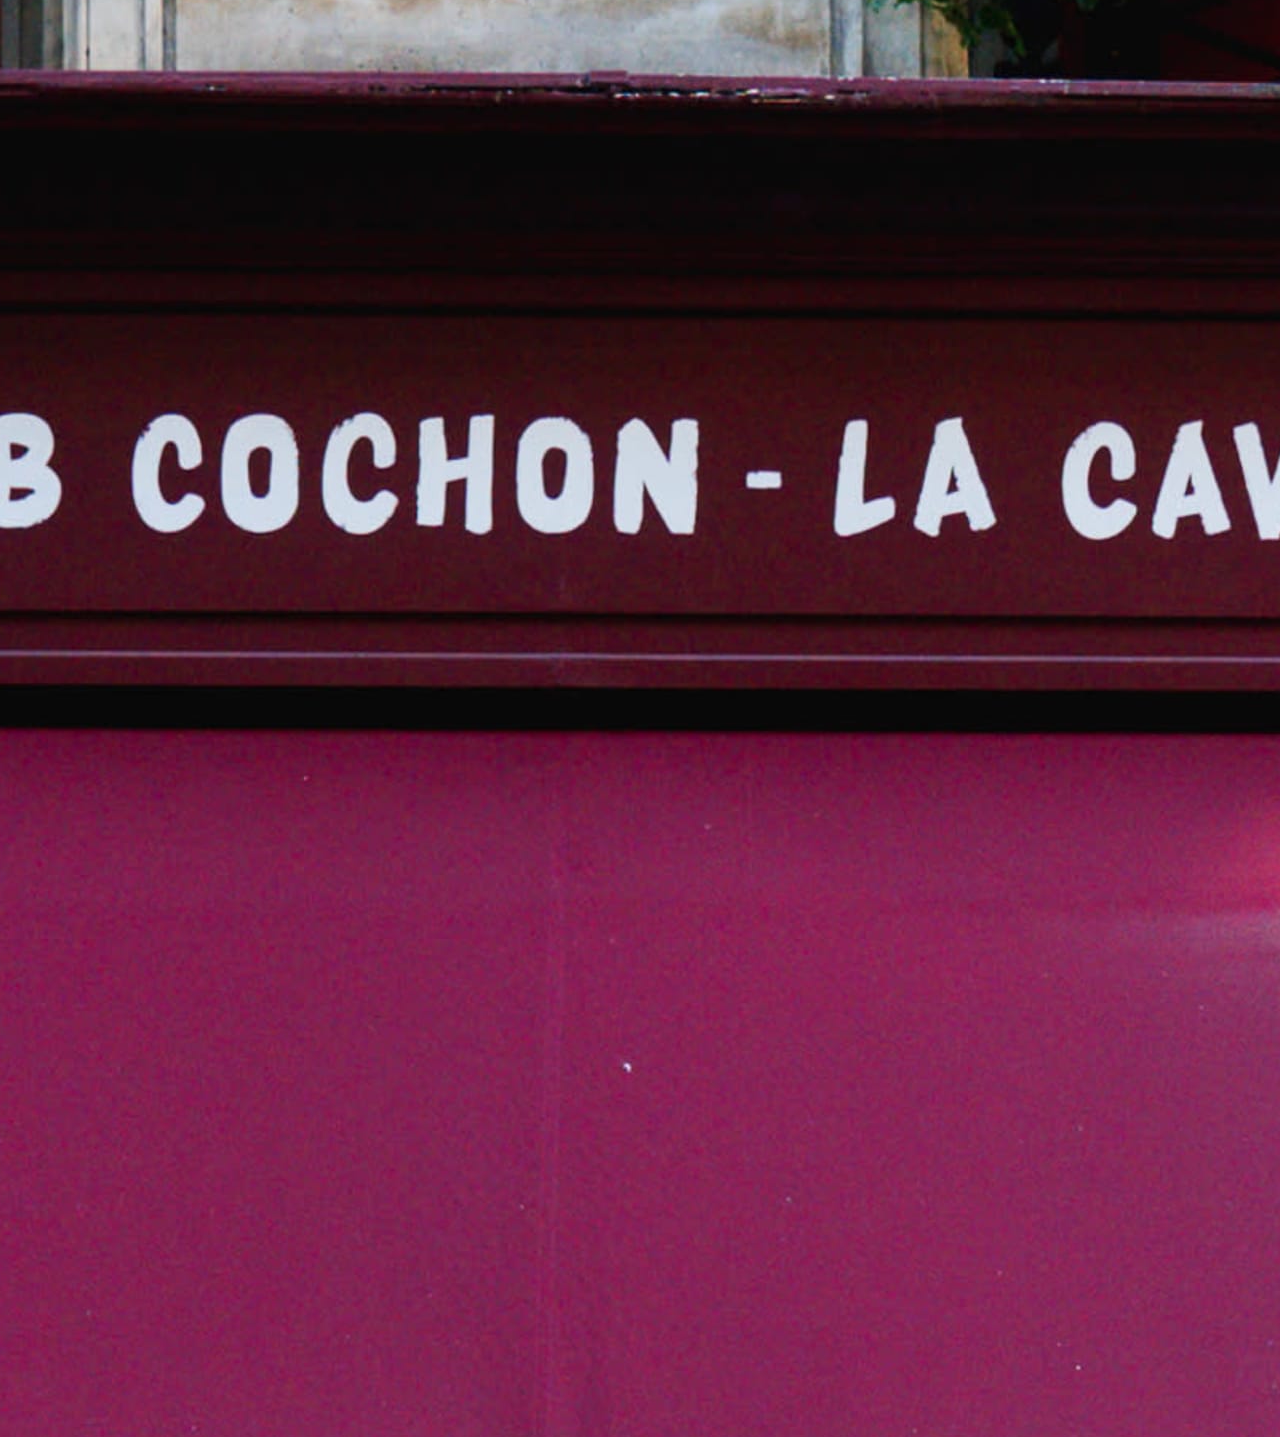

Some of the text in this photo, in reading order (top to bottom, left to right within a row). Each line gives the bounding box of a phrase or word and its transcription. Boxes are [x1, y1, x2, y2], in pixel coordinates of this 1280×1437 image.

[132, 412, 699, 535] COCHON
[746, 470, 782, 490] -
[833, 417, 997, 537] LA
